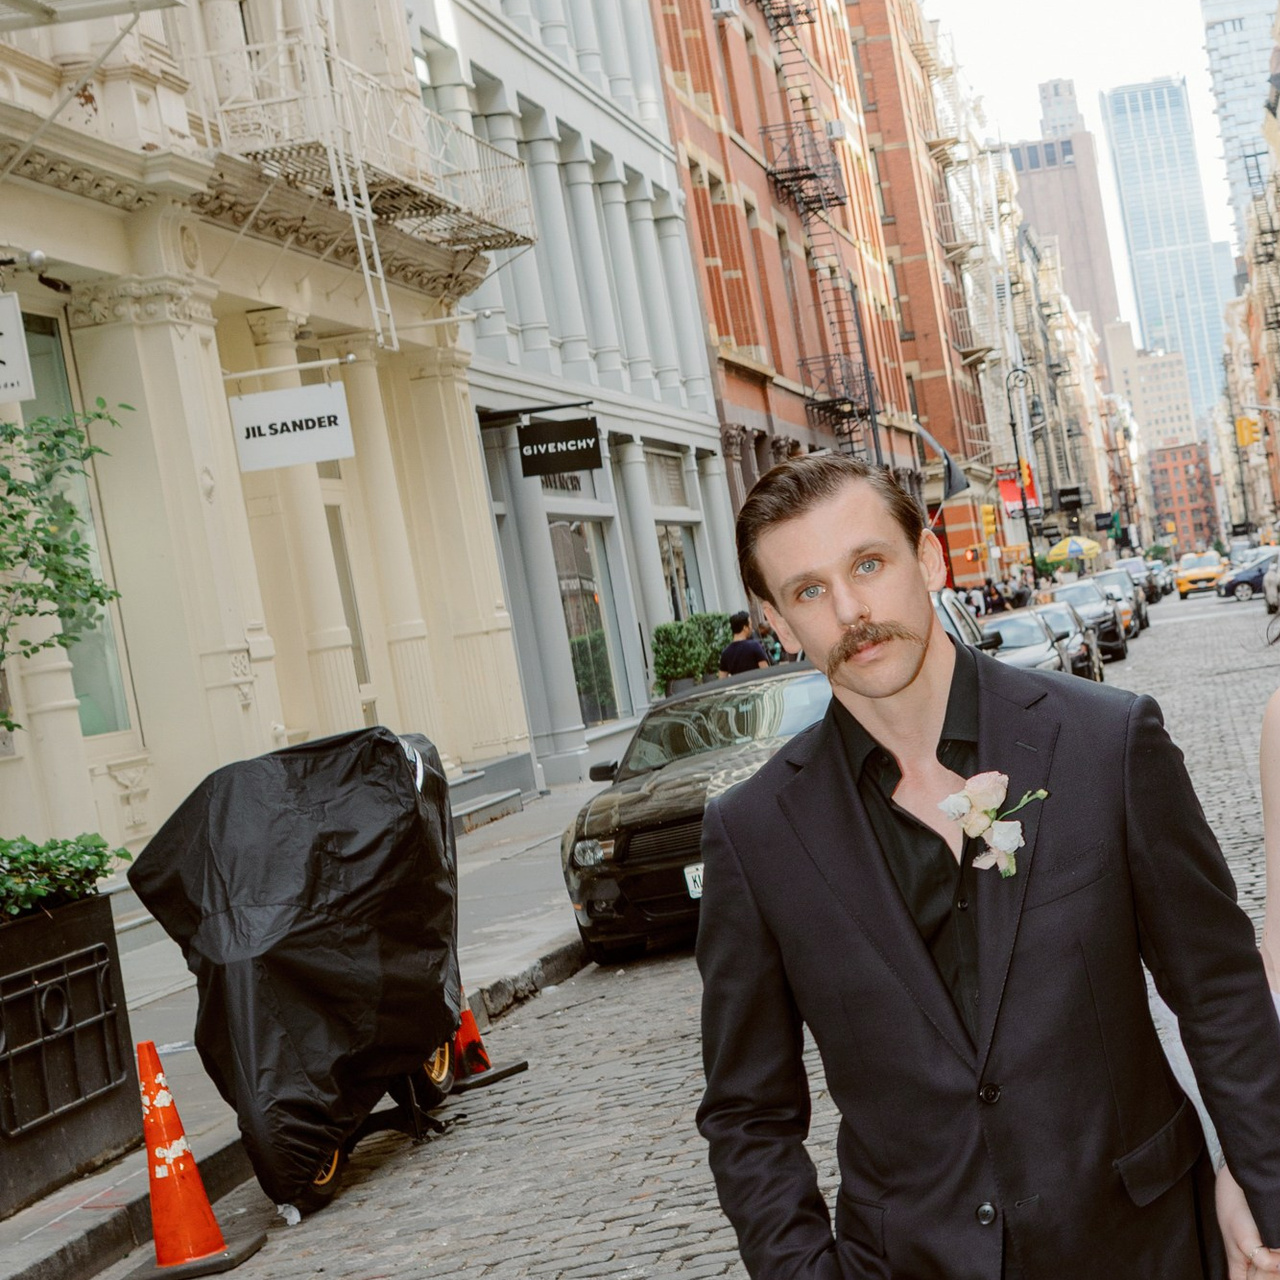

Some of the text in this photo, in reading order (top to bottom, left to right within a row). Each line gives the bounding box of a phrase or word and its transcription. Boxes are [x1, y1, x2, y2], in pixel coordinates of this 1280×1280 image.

[245, 414, 339, 439] JIL SANDER
[522, 437, 596, 456] GIVENCHY
